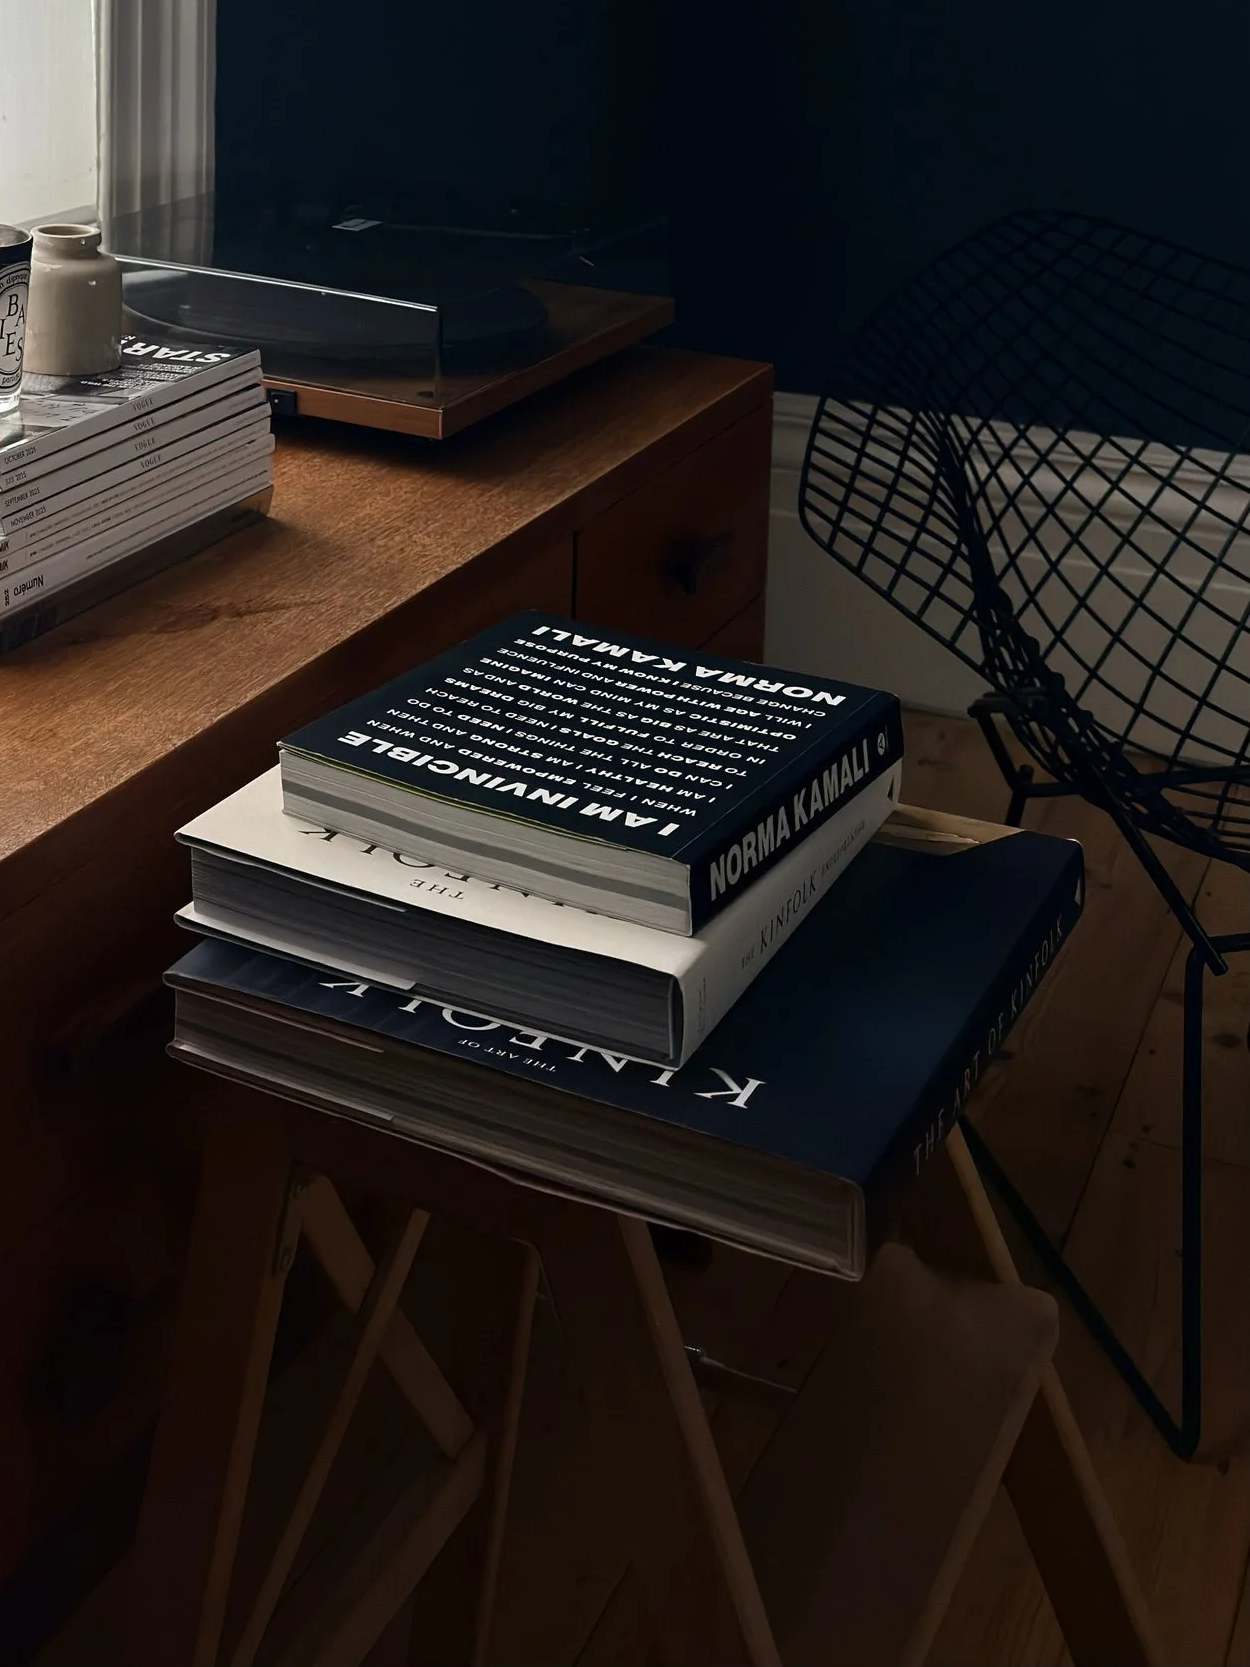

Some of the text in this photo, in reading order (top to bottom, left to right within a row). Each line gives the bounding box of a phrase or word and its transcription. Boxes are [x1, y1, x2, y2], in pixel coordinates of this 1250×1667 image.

[121, 340, 231, 363] STAR
[13, 575, 44, 597] Numéro
[513, 638, 591, 663] PURPOSE
[497, 647, 580, 675] INFLUENCE
[531, 626, 846, 706] NORMA KAMALI
[590, 661, 618, 670] MY
[582, 671, 615, 683] AND
[618, 667, 672, 684] KNOW
[425, 687, 479, 708] REACH
[480, 657, 796, 740] OPTIMISTIC AS MY MIND CAN IMAGINE
[615, 681, 676, 699] POWER
[679, 682, 748, 701] BECAUSE
[407, 698, 430, 709] DO
[433, 706, 453, 717] TO
[462, 667, 779, 752] THAT ARE AS BIG AS THE WORLD AND AS
[481, 704, 501, 714] TO
[677, 696, 721, 710] WITH
[725, 706, 762, 717] AGE
[749, 699, 826, 717] CHANGE
[386, 708, 429, 725] THEN
[444, 677, 766, 764] IN ORDER TO FULFILL MY BIG DREAMS
[456, 713, 505, 732] NEED
[505, 711, 550, 728] NEED
[764, 714, 802, 727] WILL
[366, 719, 415, 739] WHEN
[432, 722, 467, 736] AND
[559, 726, 619, 746] GOALS
[419, 736, 455, 750] AND
[470, 734, 543, 758] STRONG
[514, 730, 575, 752] THINGS
[621, 742, 654, 754] THE
[545, 755, 573, 767] AM
[580, 748, 613, 761] THE
[620, 758, 651, 768] ALL
[657, 752, 722, 770] REACH
[458, 748, 576, 785] EMPOWERED
[654, 767, 682, 777] DO
[725, 767, 747, 776] TO
[338, 731, 680, 836] I AM INVINCIBLE
[585, 767, 674, 792] HEALTHY
[685, 774, 723, 787] CAN
[582, 782, 627, 798] FEEL
[676, 788, 706, 799] AM
[641, 798, 697, 817] WHEN
[709, 805, 791, 901] NORMA
[794, 737, 870, 831] KAMALI
[410, 879, 465, 901] THE
[760, 875, 816, 954] KINFOLK
[913, 1107, 944, 1176] THE
[987, 1012, 1003, 1055] OF
[1010, 914, 1062, 1021] KINFOLK
[457, 1038, 557, 1072] THE ART OF
